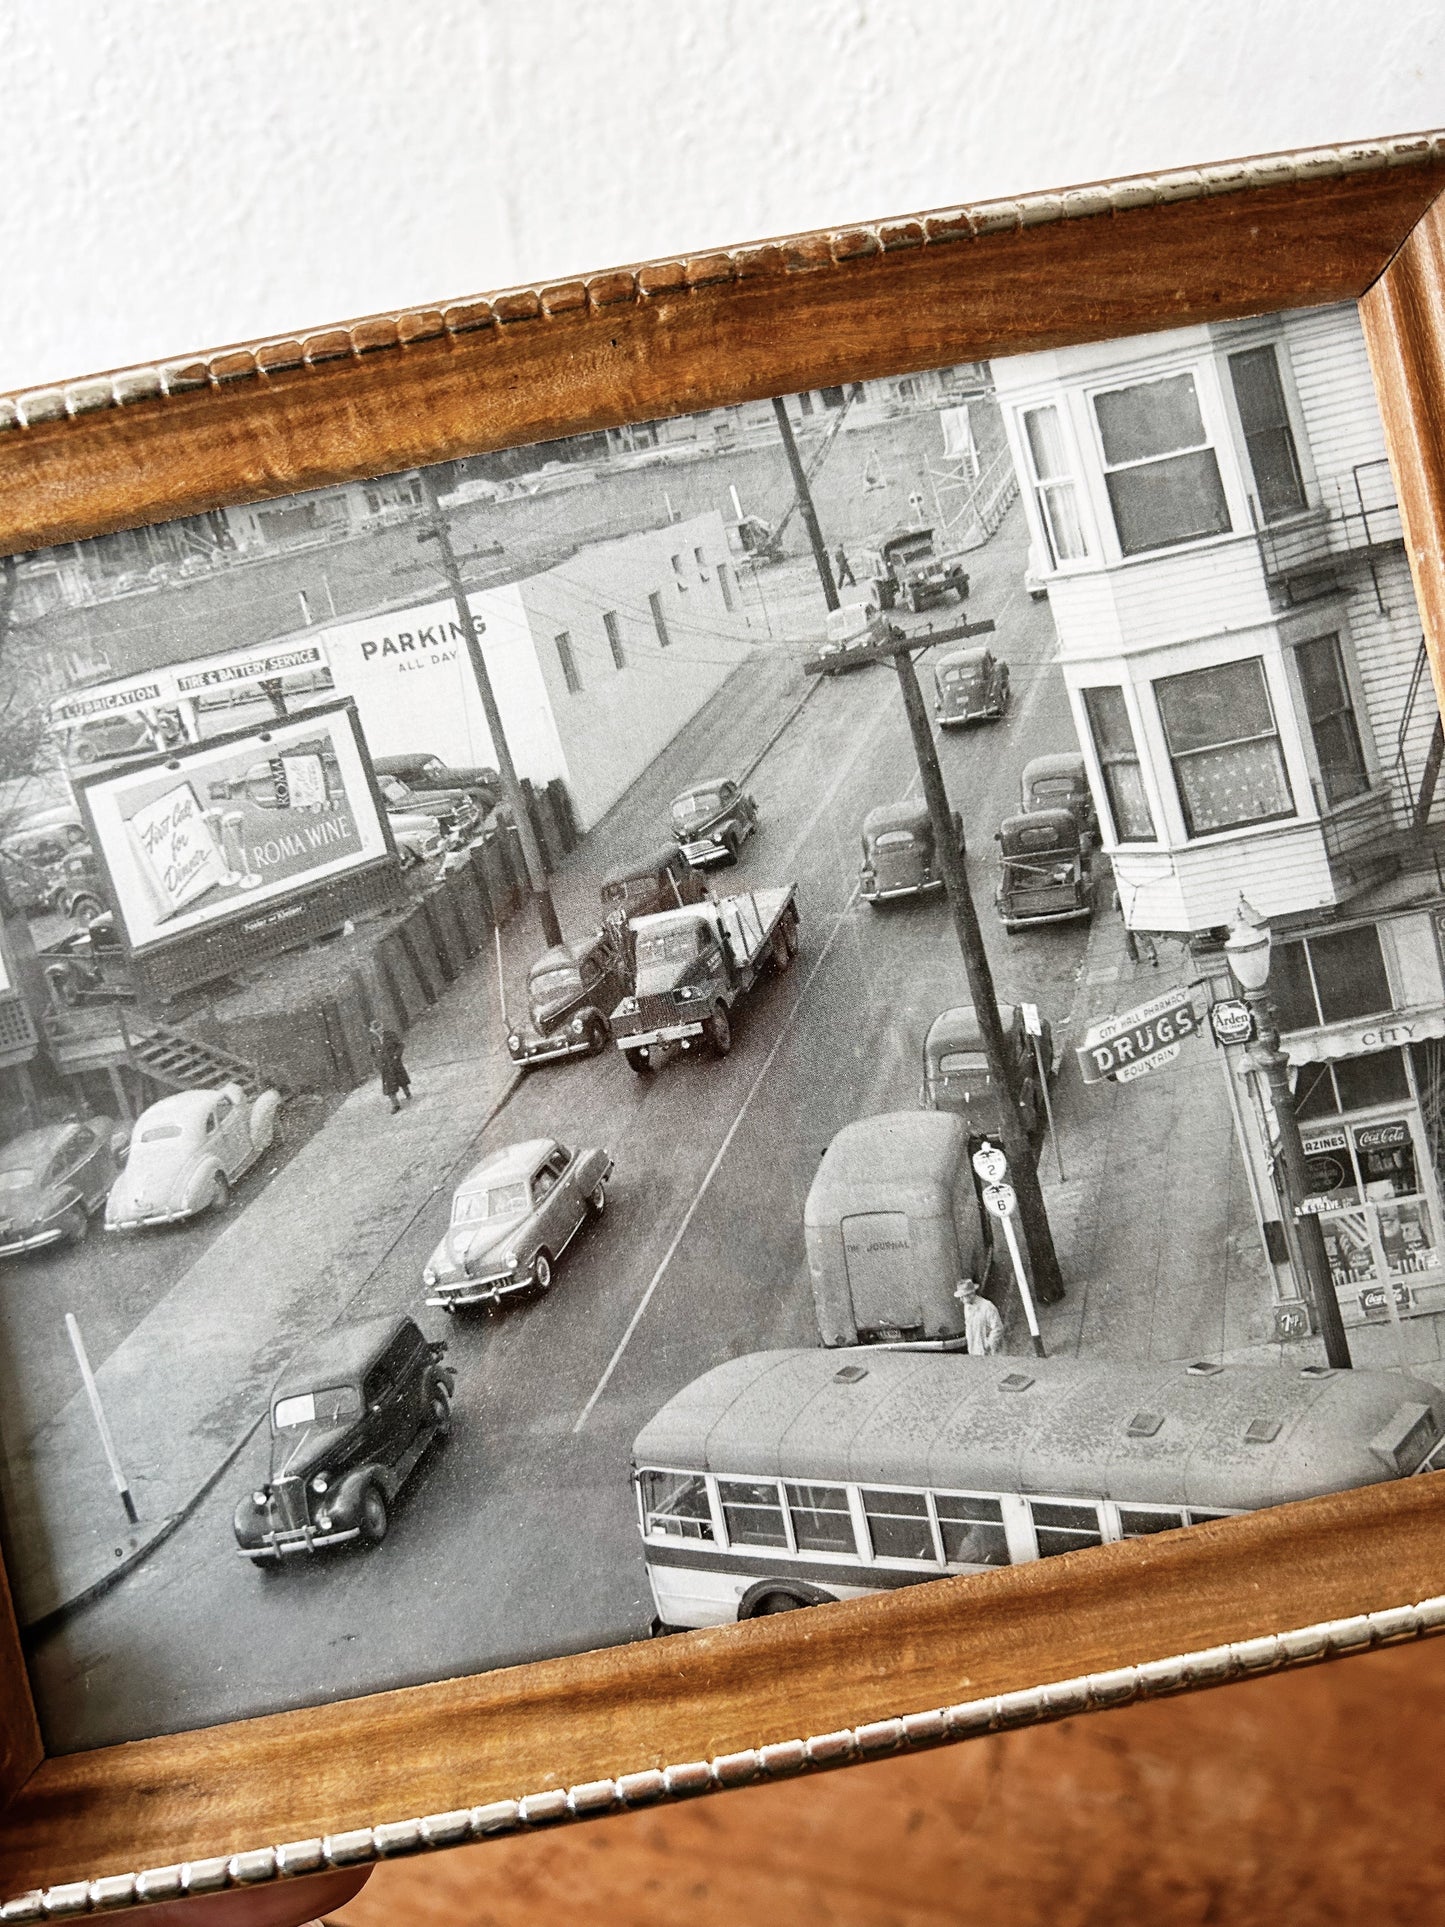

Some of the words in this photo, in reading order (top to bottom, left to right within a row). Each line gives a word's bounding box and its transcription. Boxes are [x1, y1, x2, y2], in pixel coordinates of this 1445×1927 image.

[361, 615, 487, 661] PARKING
[181, 672, 206, 690] TIRE
[219, 661, 268, 682] BATTERY
[270, 650, 316, 670] SERVICE
[399, 659, 424, 673] ALL
[431, 650, 457, 665] DAY
[64, 686, 157, 718] LUBRICATION
[271, 759, 290, 806] ROMA
[252, 832, 306, 868] ROMA
[304, 815, 352, 849] WINE
[1099, 1022, 1118, 1040] CITY
[1121, 1013, 1141, 1027] HALL
[1143, 990, 1187, 1018] PHARMACY
[1216, 1012, 1248, 1026] Arden
[1092, 1007, 1193, 1071] DRUGS
[1361, 1022, 1416, 1046] CITY
[1123, 1047, 1175, 1079] FOUNTAIN
[1304, 1136, 1345, 1152] AZINES
[986, 1164, 997, 1176] 2
[996, 1199, 1007, 1211] 6
[867, 1240, 910, 1253] JOURNAL
